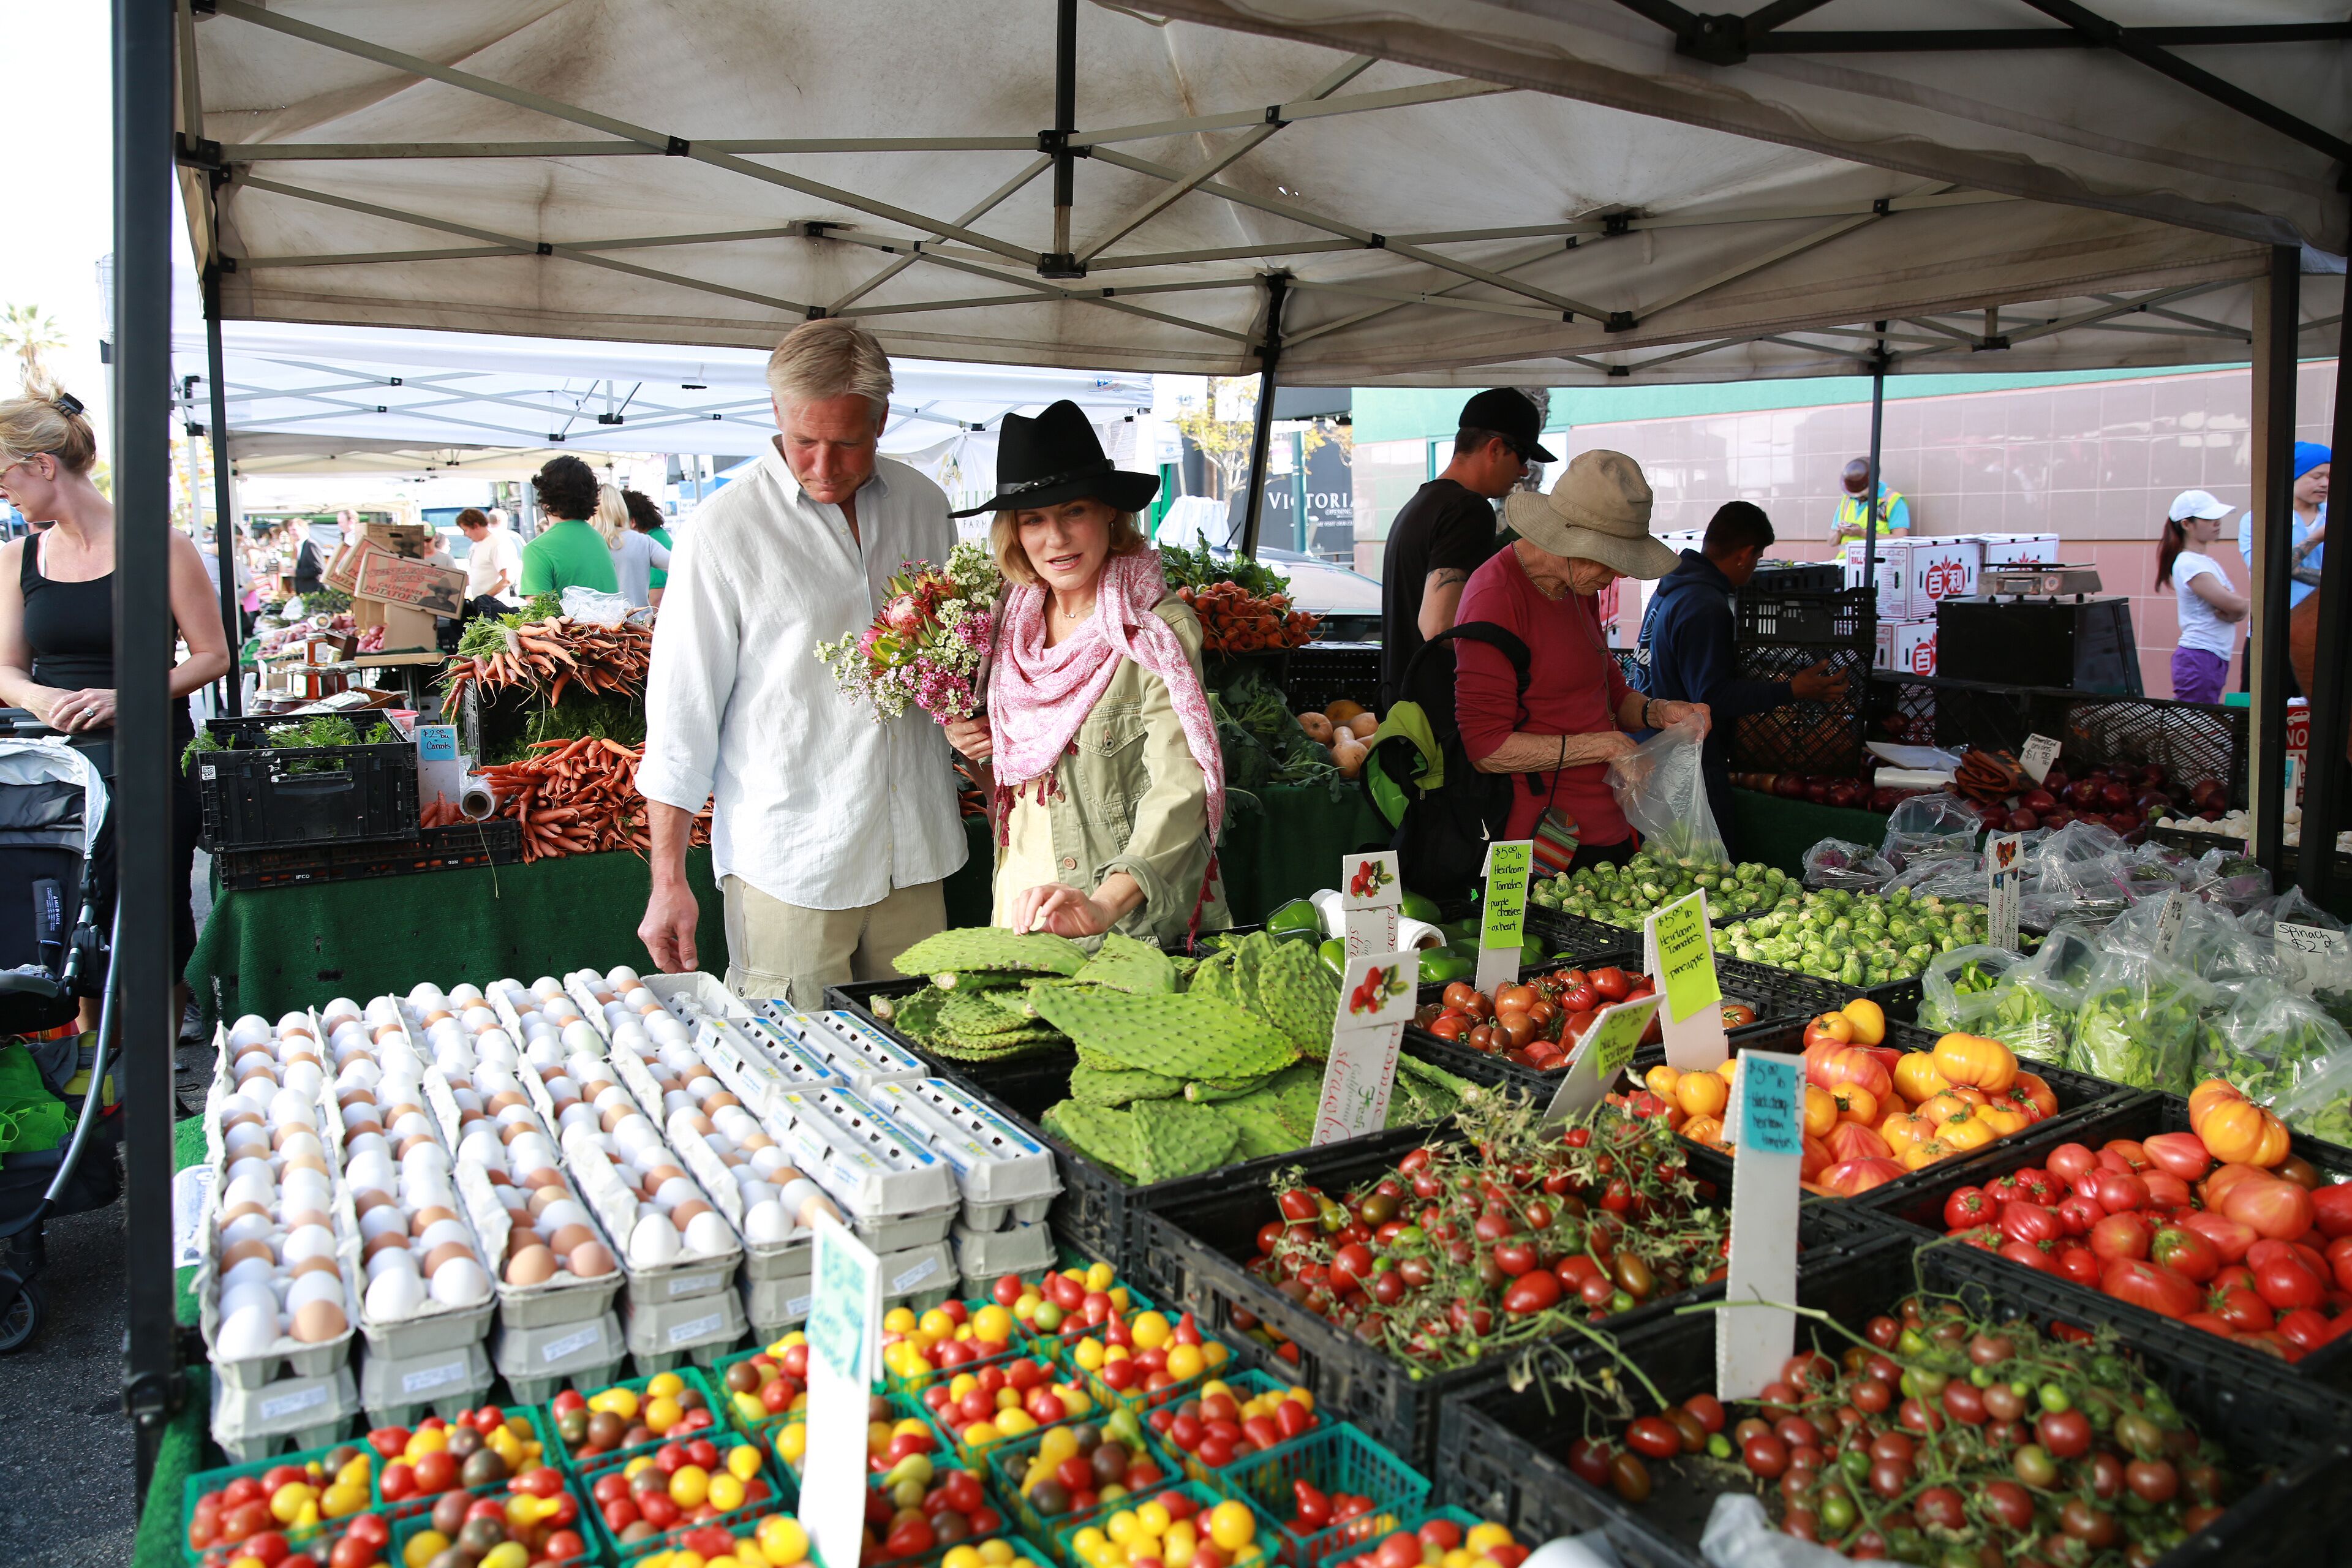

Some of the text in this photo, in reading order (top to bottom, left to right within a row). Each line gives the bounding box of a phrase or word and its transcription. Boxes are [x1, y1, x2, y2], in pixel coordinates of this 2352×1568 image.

[377, 582, 423, 595] CALIFORNIA
[1928, 567, 1964, 594] 百利
[364, 585, 420, 602] POTATOES
[426, 741, 451, 750] Carrots
[2286, 728, 2308, 747] NO
[1494, 864, 1524, 875] Heirloom
[1659, 922, 1696, 947] Heirloom
[1343, 1062, 1362, 1122] California
[1353, 1085, 1376, 1129] Fresh
